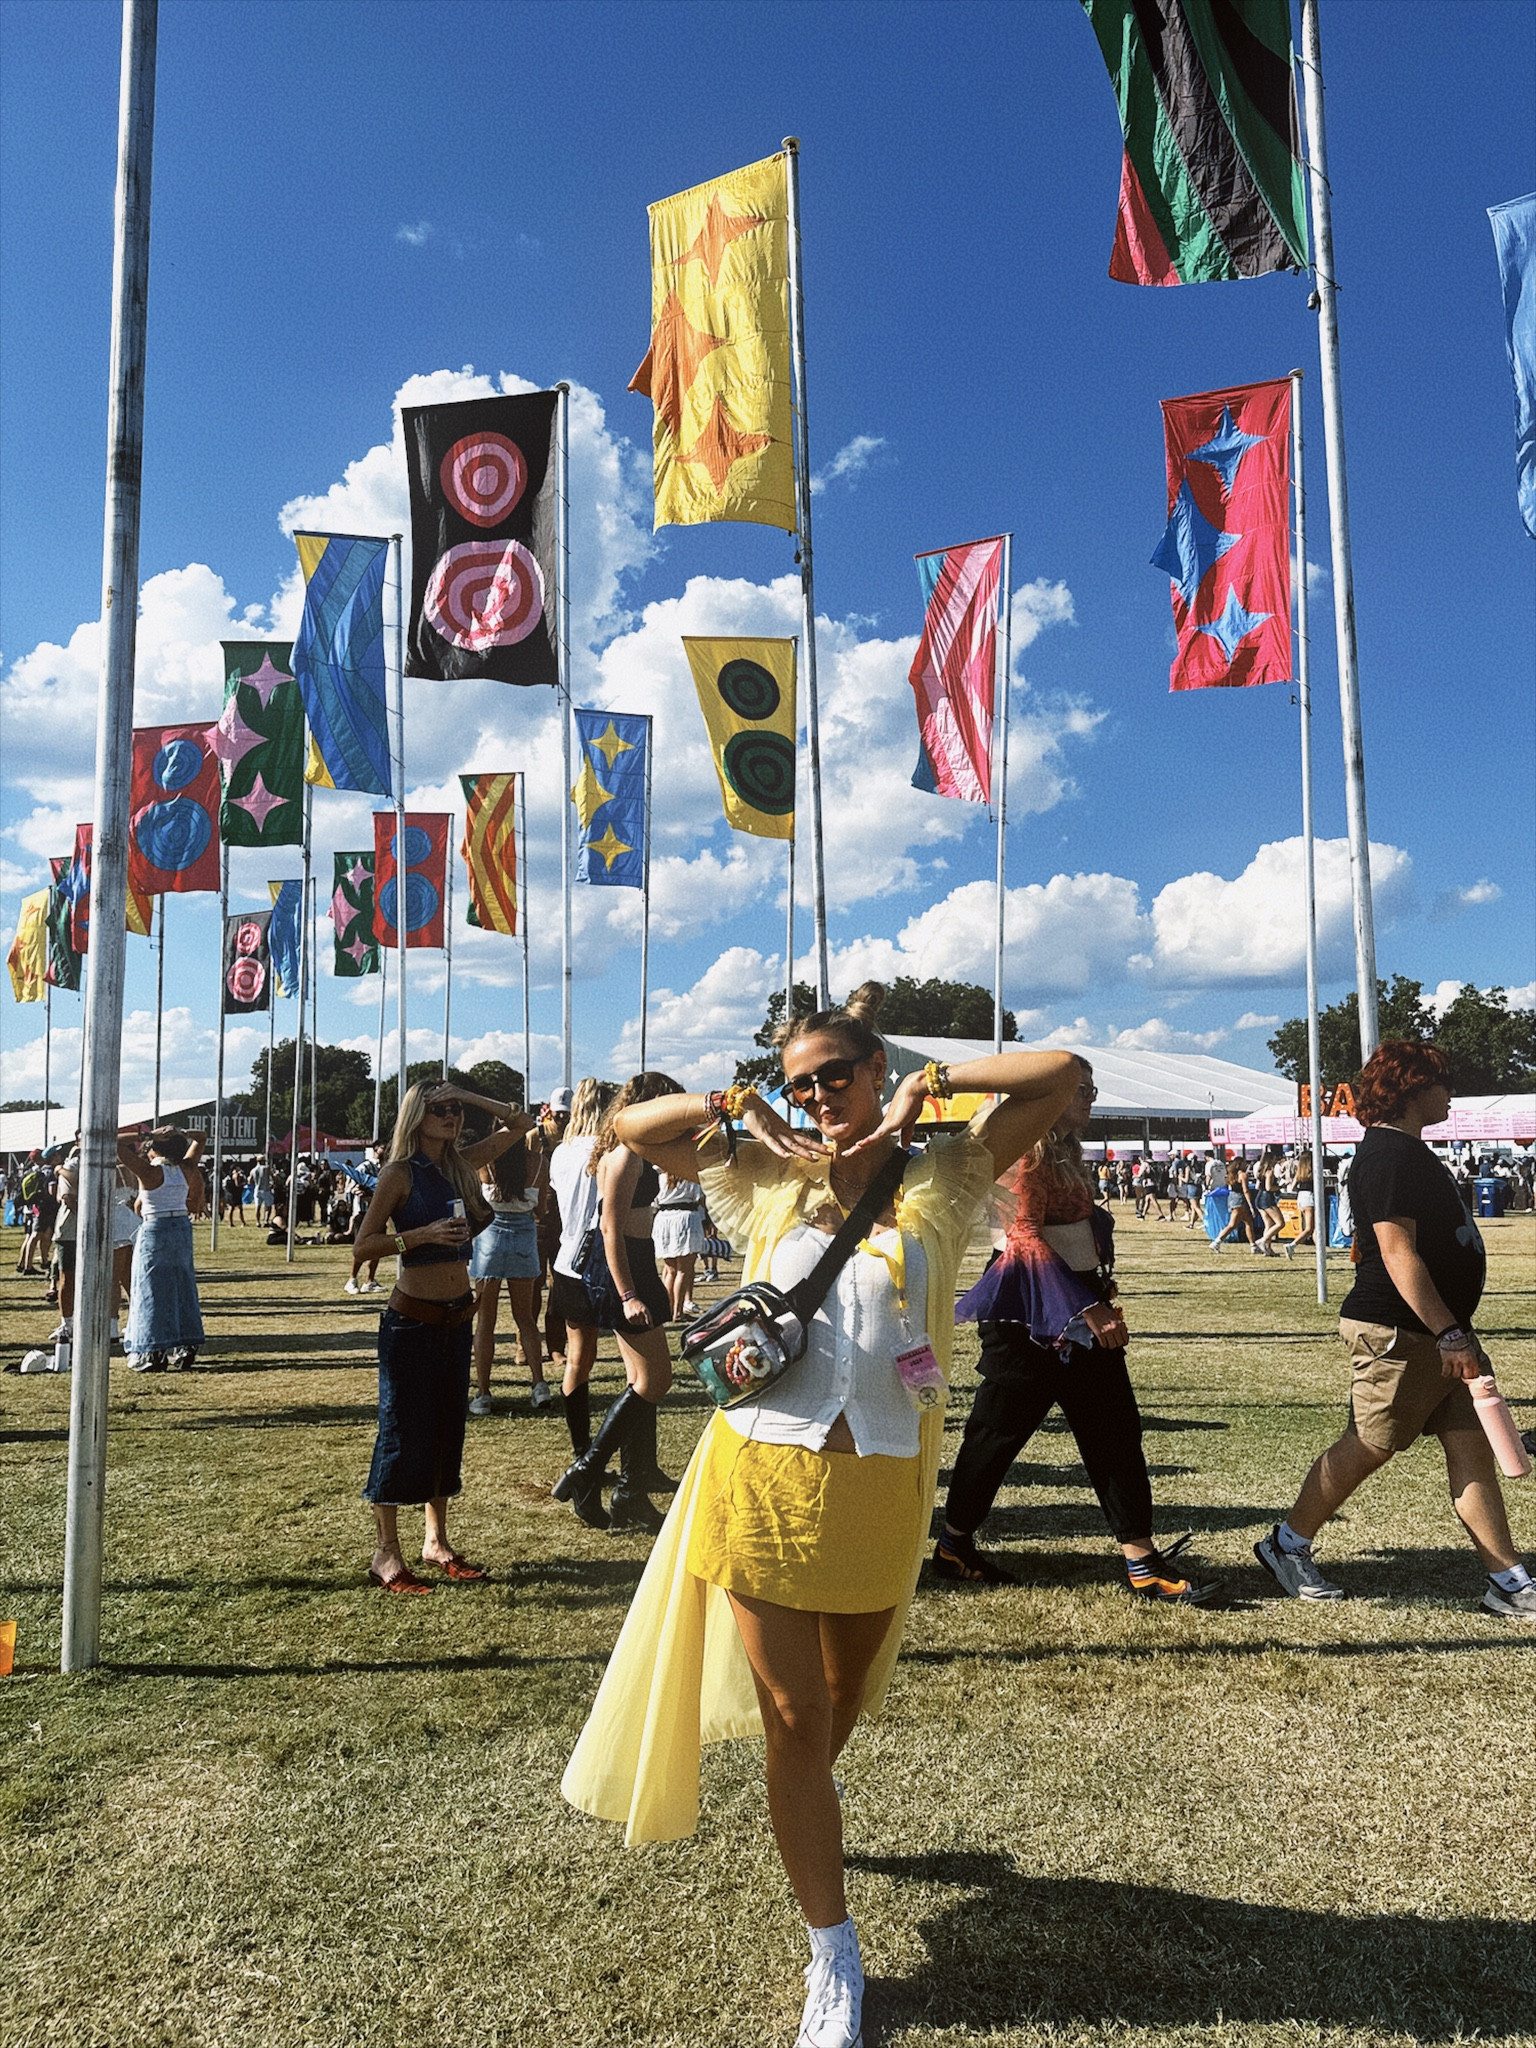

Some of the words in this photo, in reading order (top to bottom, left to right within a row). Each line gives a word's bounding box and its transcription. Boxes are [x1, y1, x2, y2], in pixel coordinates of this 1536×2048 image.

[210, 1115, 229, 1137] BG
[232, 1116, 258, 1138] TENT
[1213, 1128, 1226, 1137] BAR
